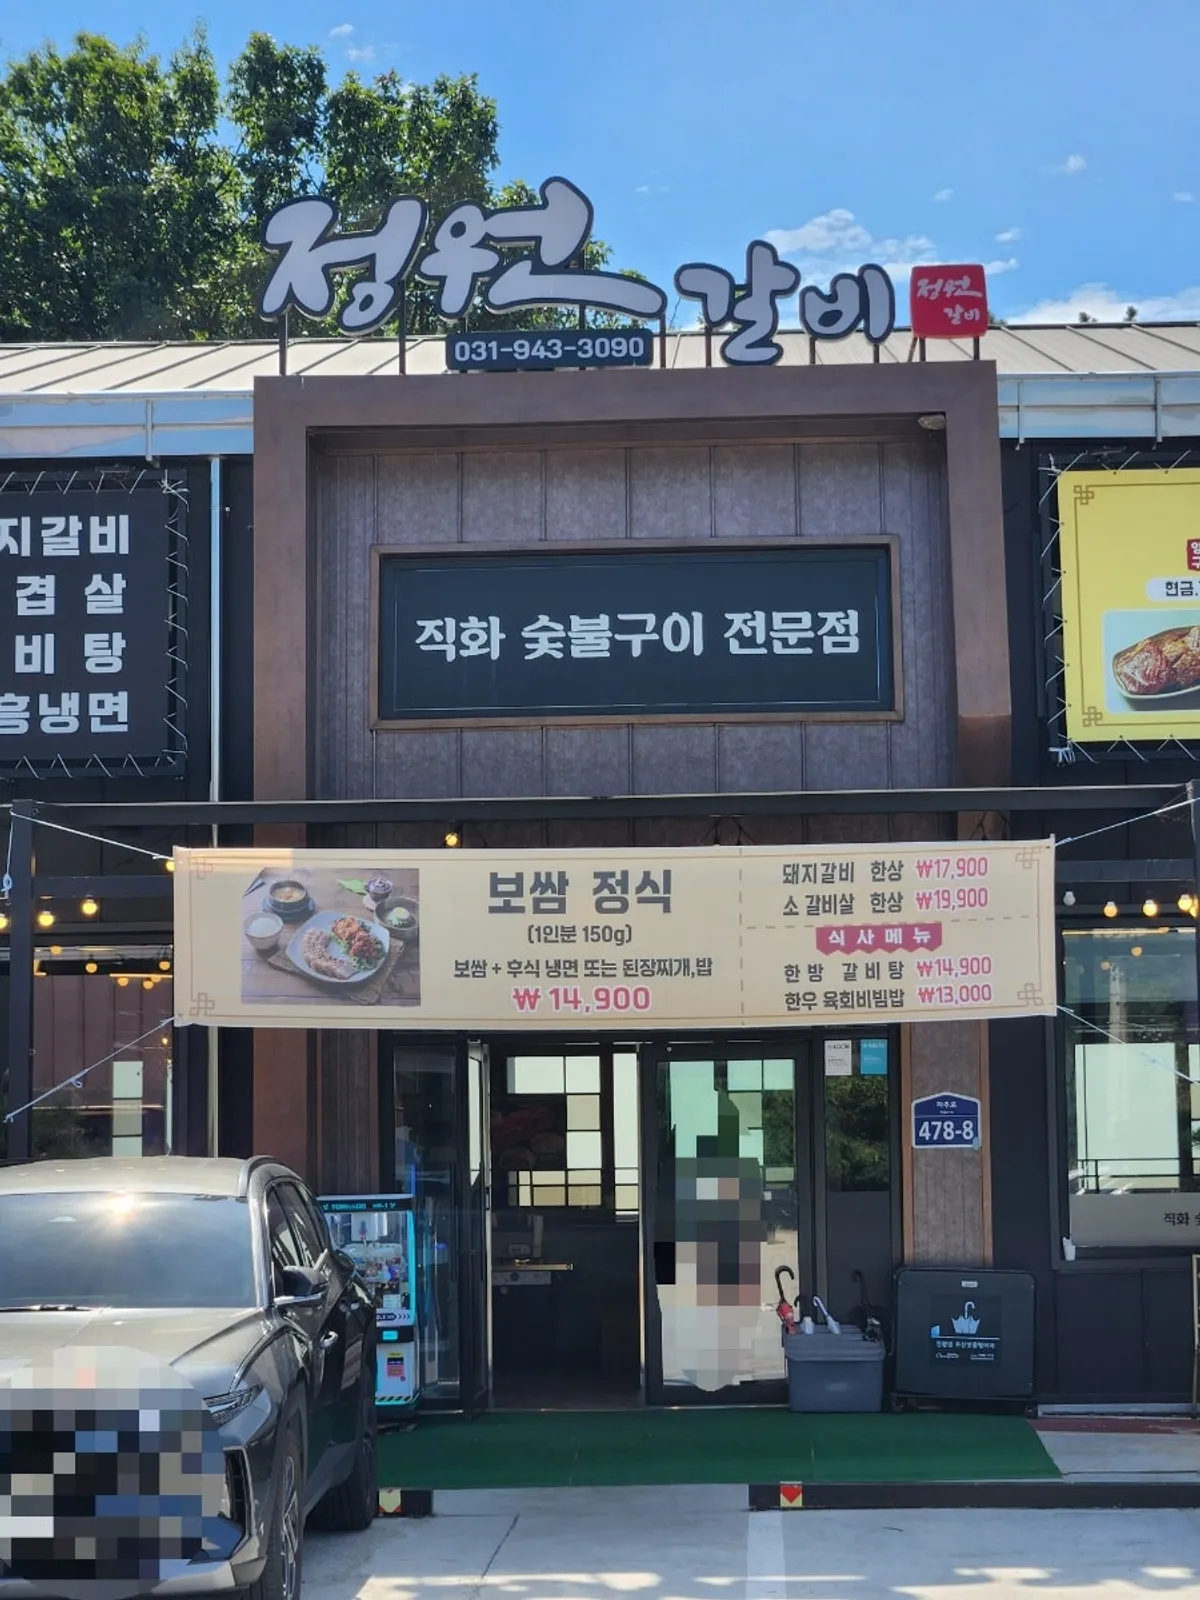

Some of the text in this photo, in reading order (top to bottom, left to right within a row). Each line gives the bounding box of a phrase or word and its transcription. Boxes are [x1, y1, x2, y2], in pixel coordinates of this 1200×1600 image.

[258, 175, 895, 364] 정원 갈비
[916, 275, 983, 300] 정원
[943, 304, 980, 325] 갈비
[454, 336, 645, 363] 031-943-3090
[415, 609, 860, 662] 직화 숯불구이 전문점
[783, 857, 988, 885] 돼지갈비 한상 ₩17,900
[488, 870, 671, 914] 보쌈 정식
[782, 887, 988, 916] 소 갈비살 한상 ₩19,900
[527, 925, 632, 946] (1인분 150g)
[454, 959, 487, 978] 보쌈
[507, 959, 540, 978] 후식
[545, 959, 579, 978] 냉면
[584, 958, 617, 977] 또는
[916, 956, 992, 978] ₩14,900
[785, 984, 992, 1012] 한우 육회비빔밥 ₩13,000
[919, 1120, 974, 1140] 478-8
[1163, 1212, 1189, 1226] 직화
